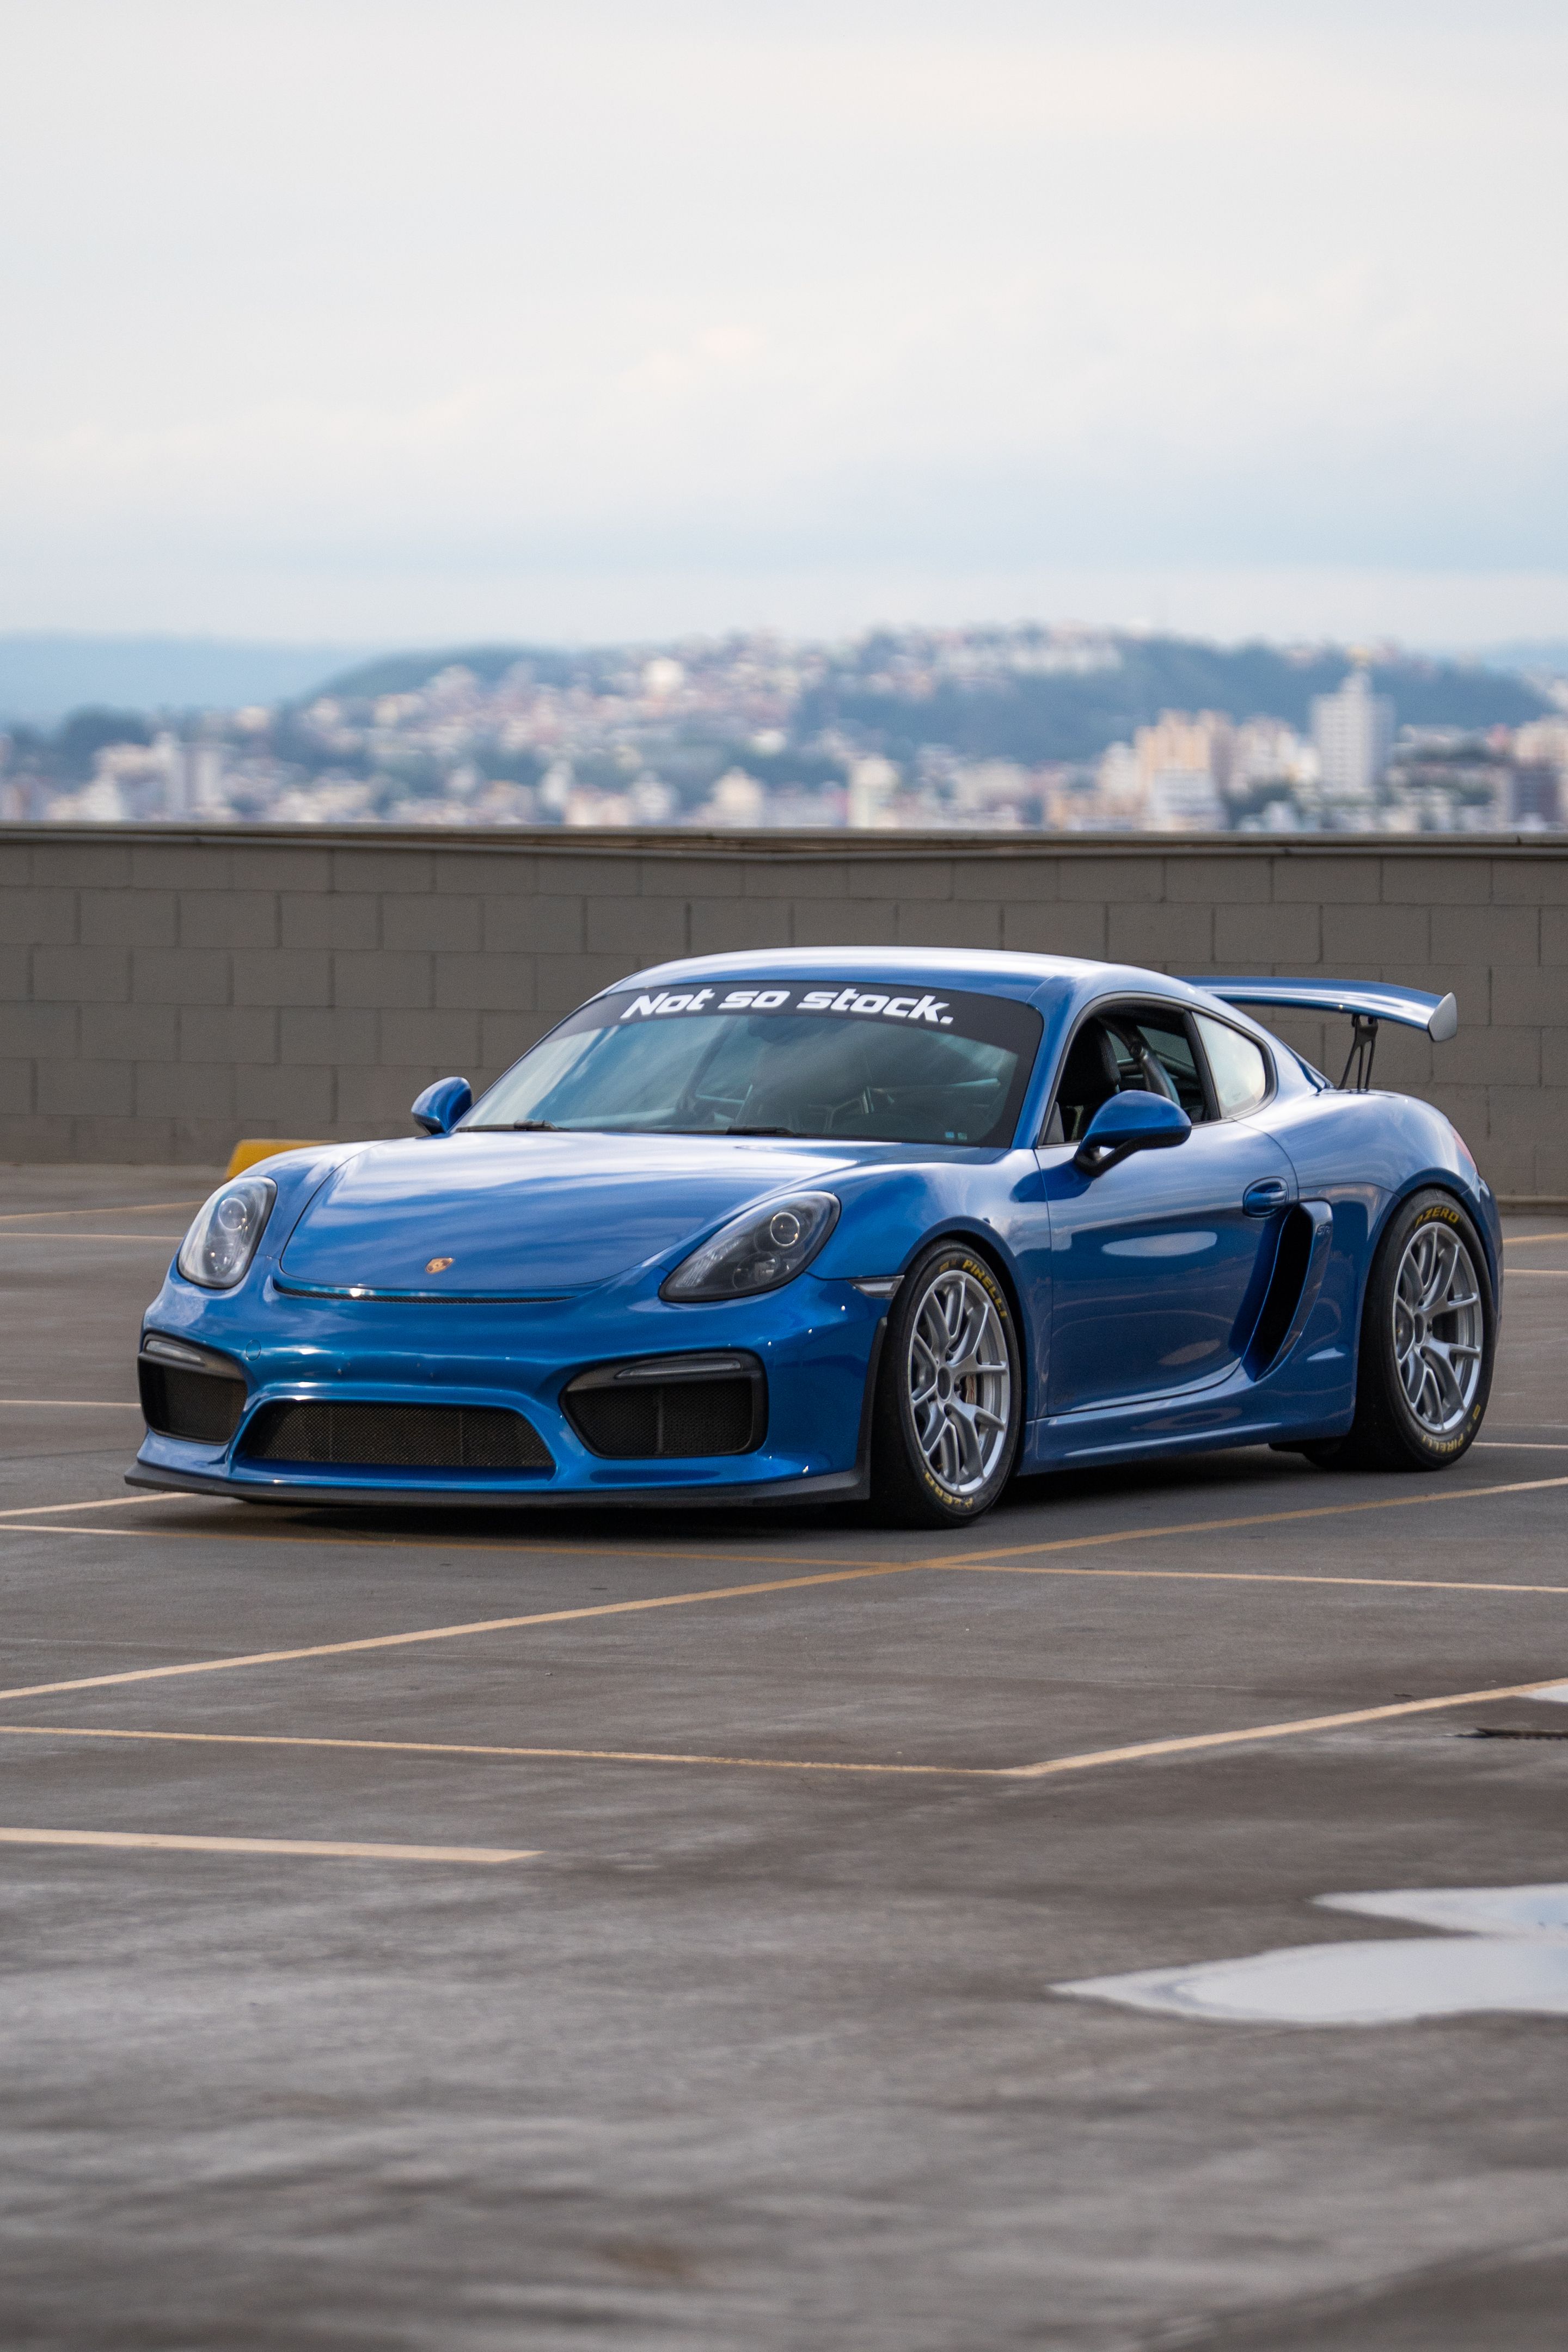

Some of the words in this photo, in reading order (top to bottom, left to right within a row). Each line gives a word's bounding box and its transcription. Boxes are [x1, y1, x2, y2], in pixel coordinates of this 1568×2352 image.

[620, 988, 715, 1020] Not
[717, 990, 791, 1009] so
[796, 988, 954, 1025] stock.
[961, 1258, 1008, 1318] PIRELLI
